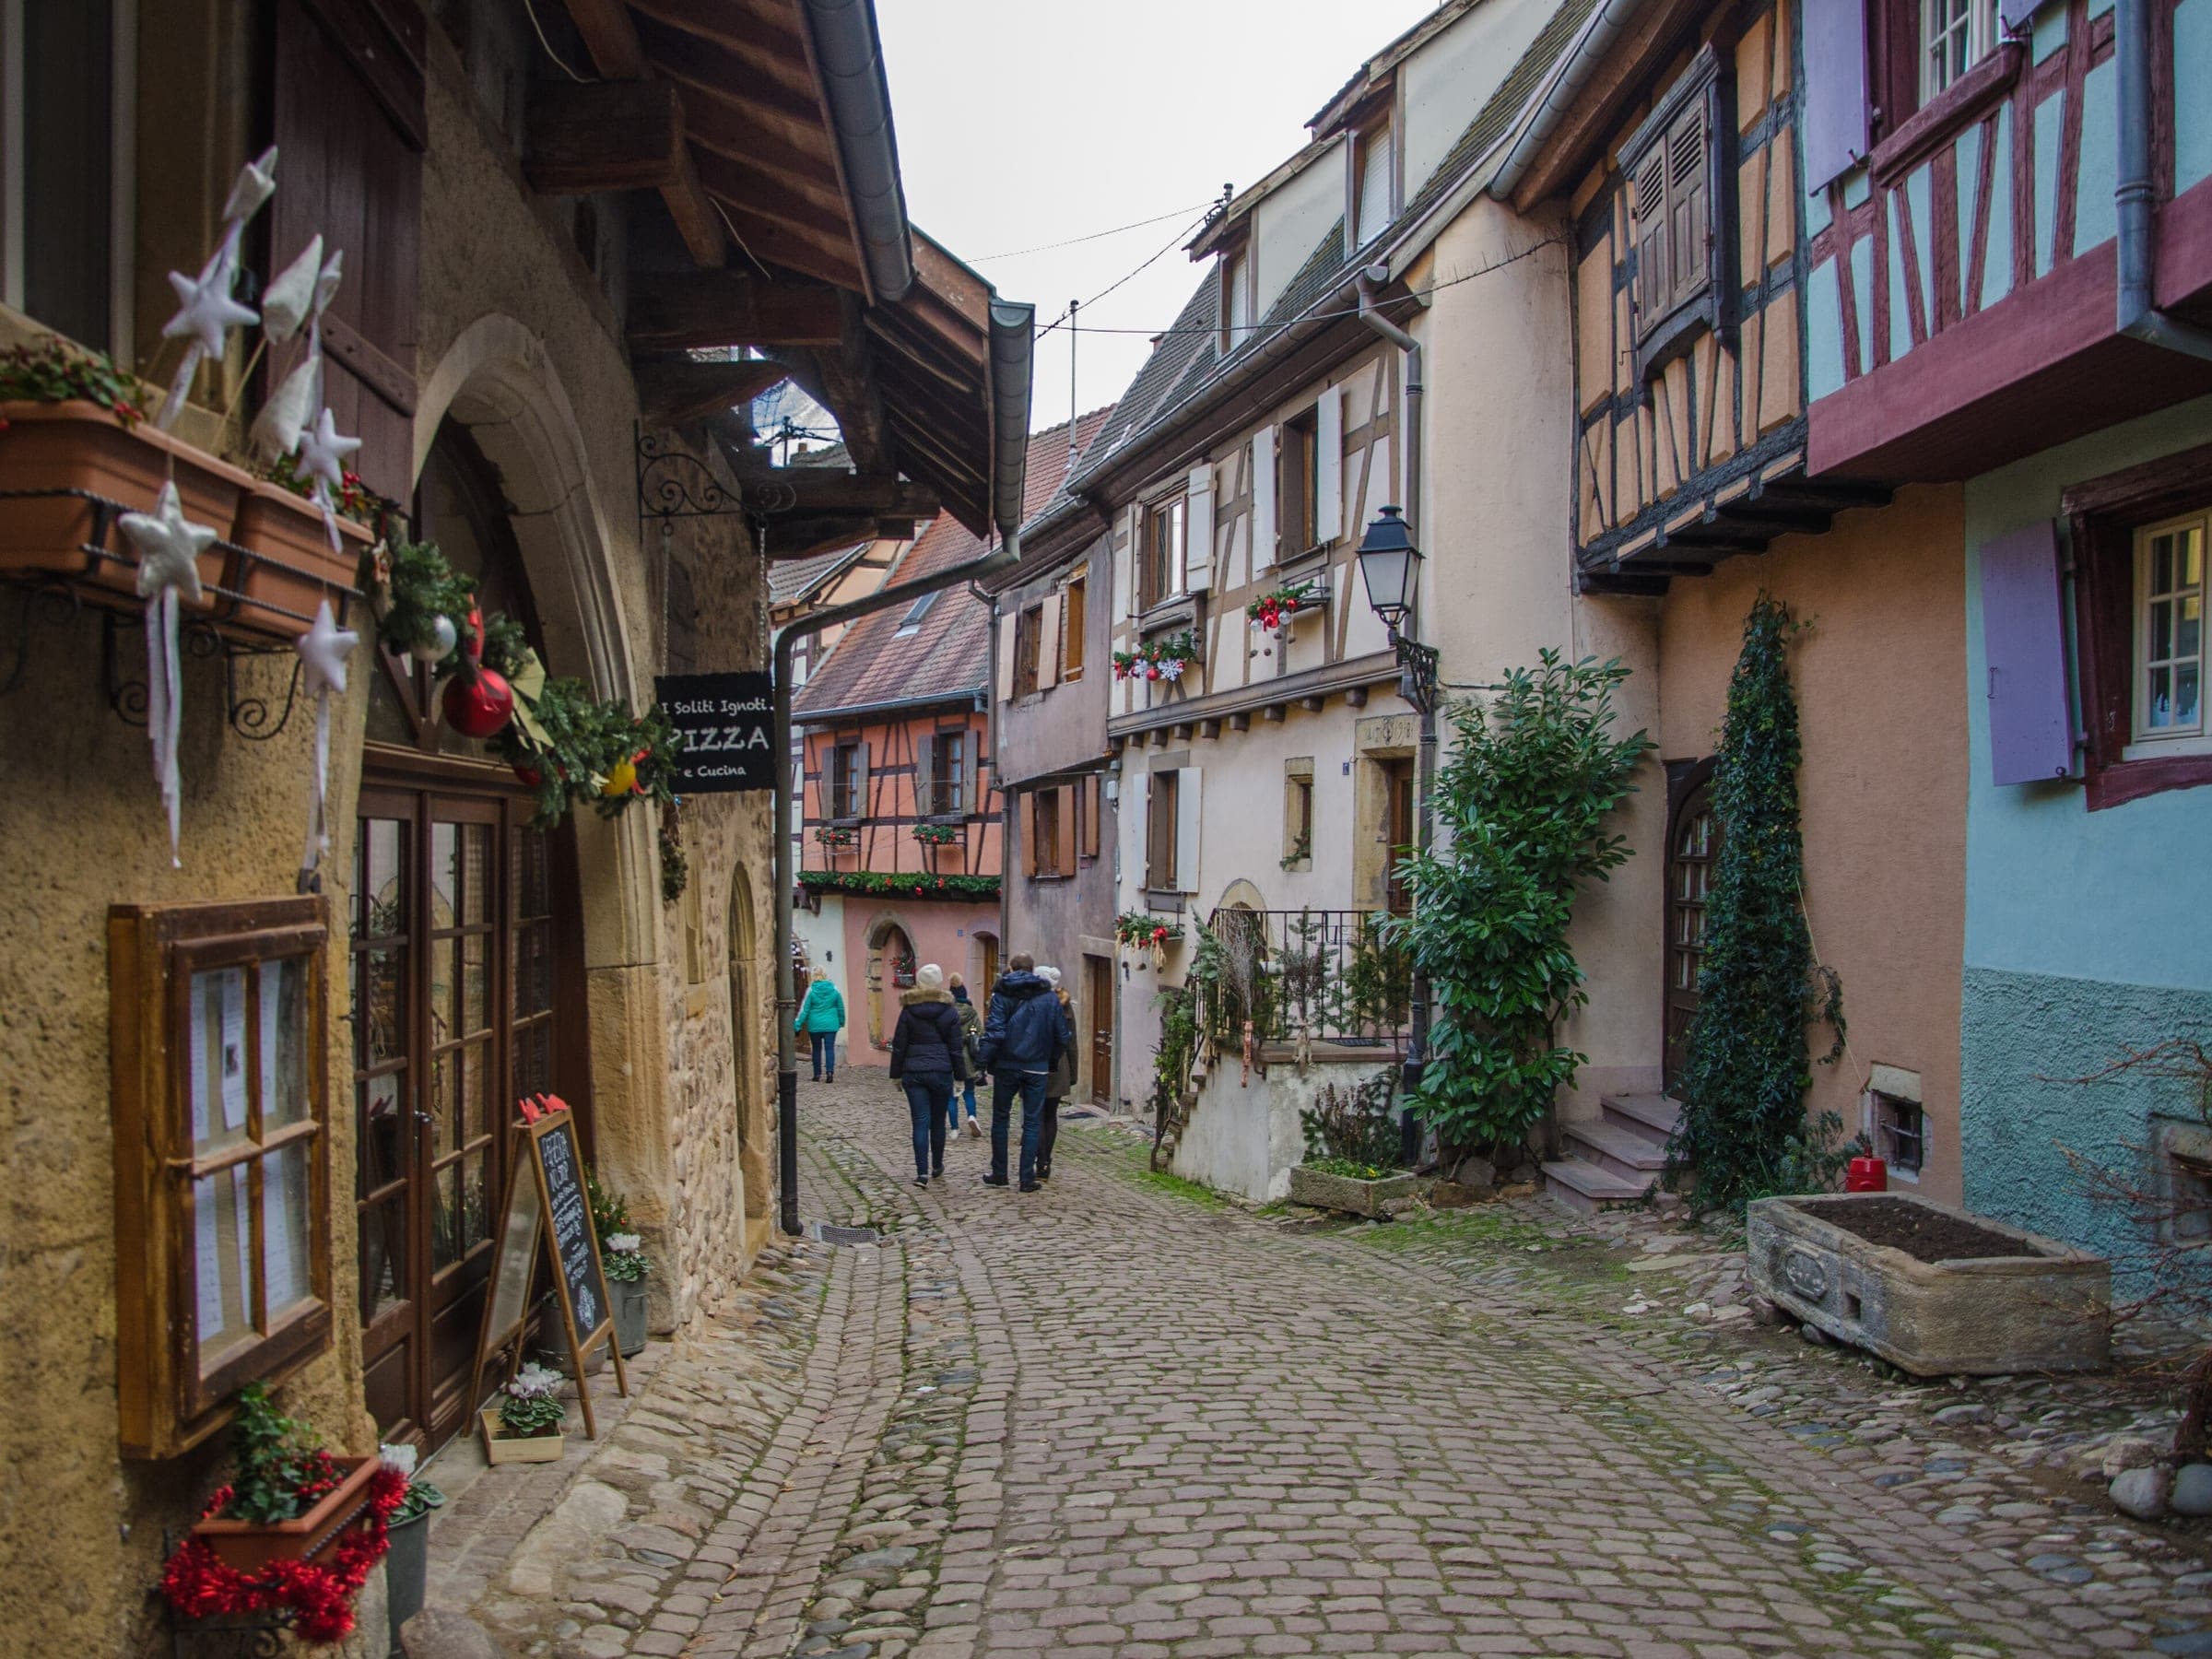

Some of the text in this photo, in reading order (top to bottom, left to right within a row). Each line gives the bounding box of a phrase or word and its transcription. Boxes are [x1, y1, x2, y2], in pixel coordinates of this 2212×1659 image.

[662, 697, 767, 716] I Soliti Ignoti
[683, 765, 747, 778] e Cucina
